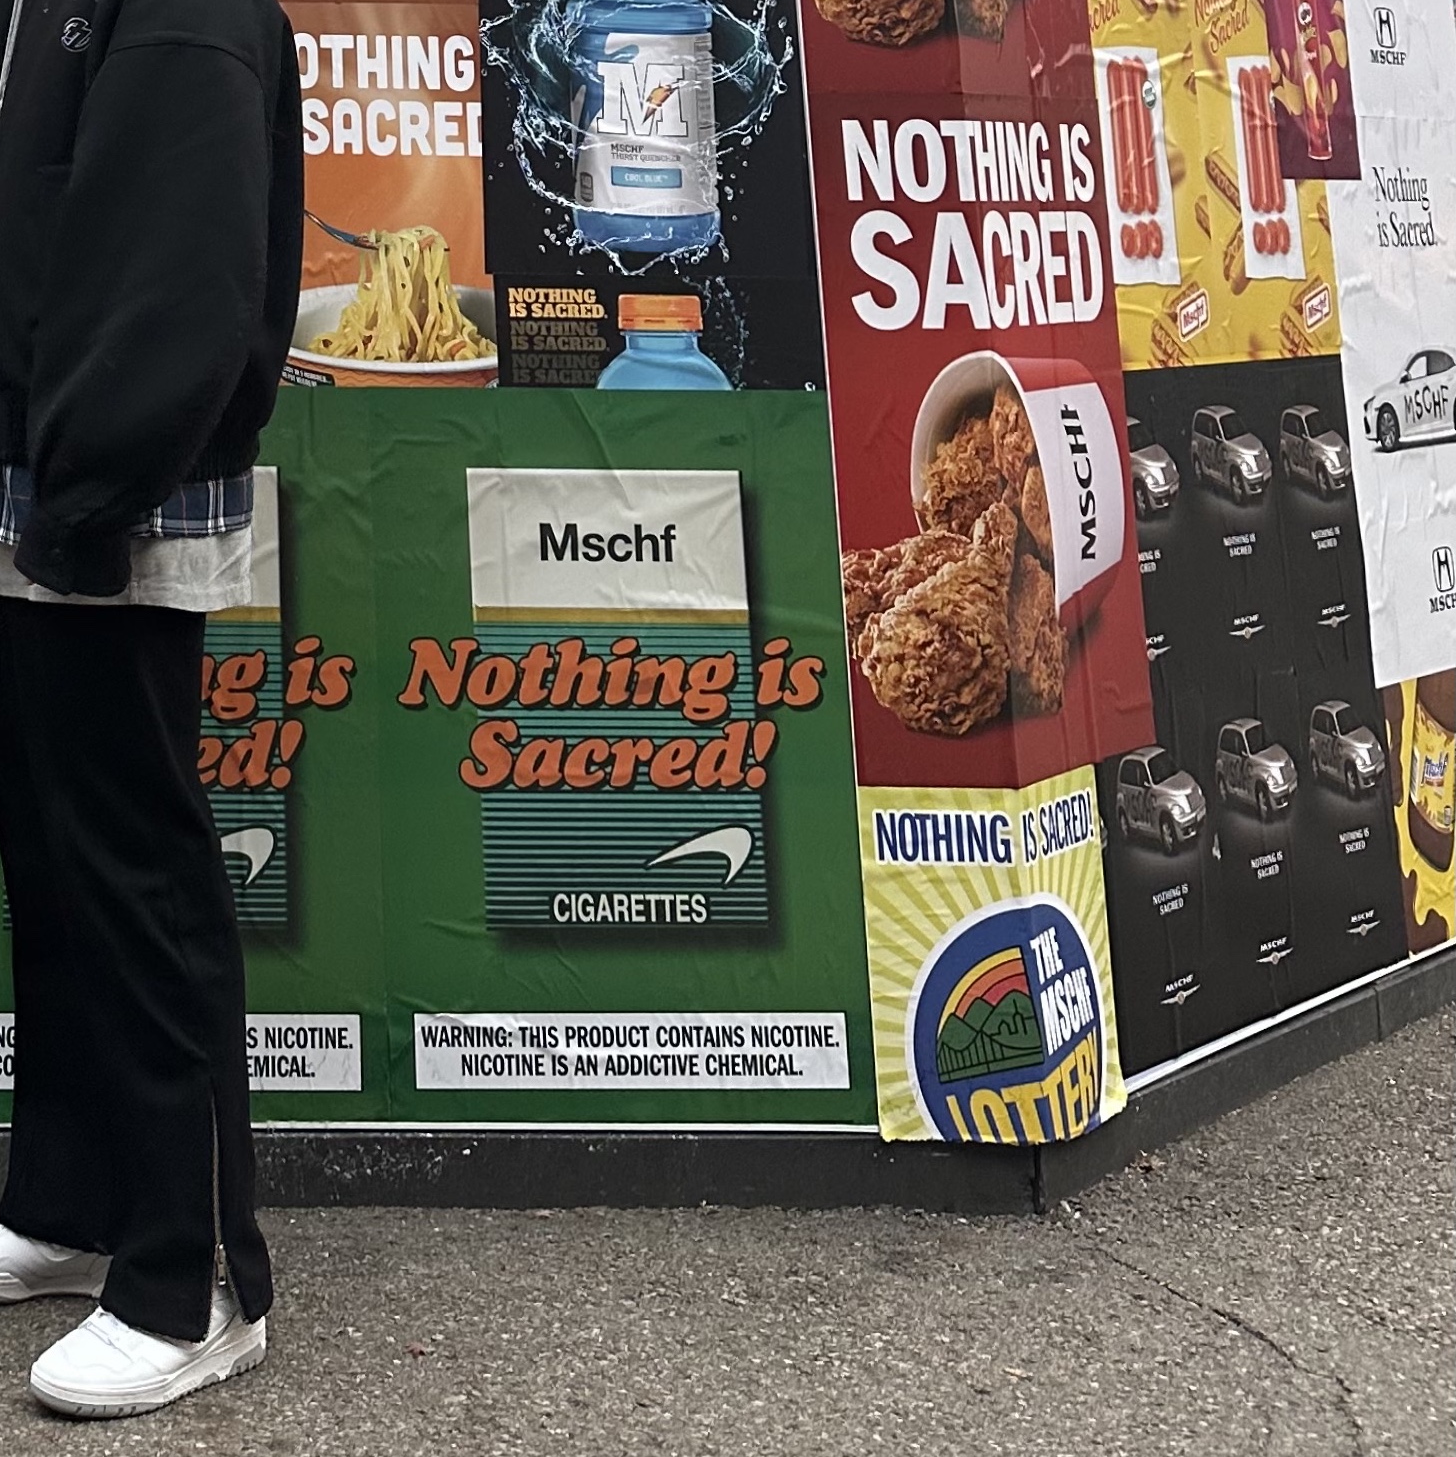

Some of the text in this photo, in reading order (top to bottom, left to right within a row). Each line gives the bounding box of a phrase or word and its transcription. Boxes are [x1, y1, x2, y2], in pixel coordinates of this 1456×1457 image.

[294, 33, 475, 91] OTHING
[1370, 49, 1406, 65] MSCHF
[842, 119, 1094, 202] NOTHING IS
[1372, 167, 1429, 211] Nothing
[1377, 211, 1437, 247] is Sacred.
[851, 210, 1103, 330] SACRED
[508, 288, 596, 303] NOTHING
[510, 303, 607, 318] IS SACRED.
[1404, 385, 1448, 423] MSCHF
[540, 523, 676, 562] Mschf
[286, 638, 353, 705] is
[400, 638, 822, 722] Nothing is
[461, 720, 776, 788] Sacred!
[876, 792, 1093, 863] NOTHING IS SACRED!
[554, 894, 706, 923] CIGARETTES
[1030, 927, 1063, 984] THE
[1041, 967, 1094, 1055] MSCHF
[265, 1027, 353, 1049] NICOTINE.
[421, 1026, 839, 1048] WARNING: THIS PRODUCT CONTAINS NICOTINE.
[462, 1054, 803, 1077] NICOTINE IS AN ADDICTIVE CHEMICAL.
